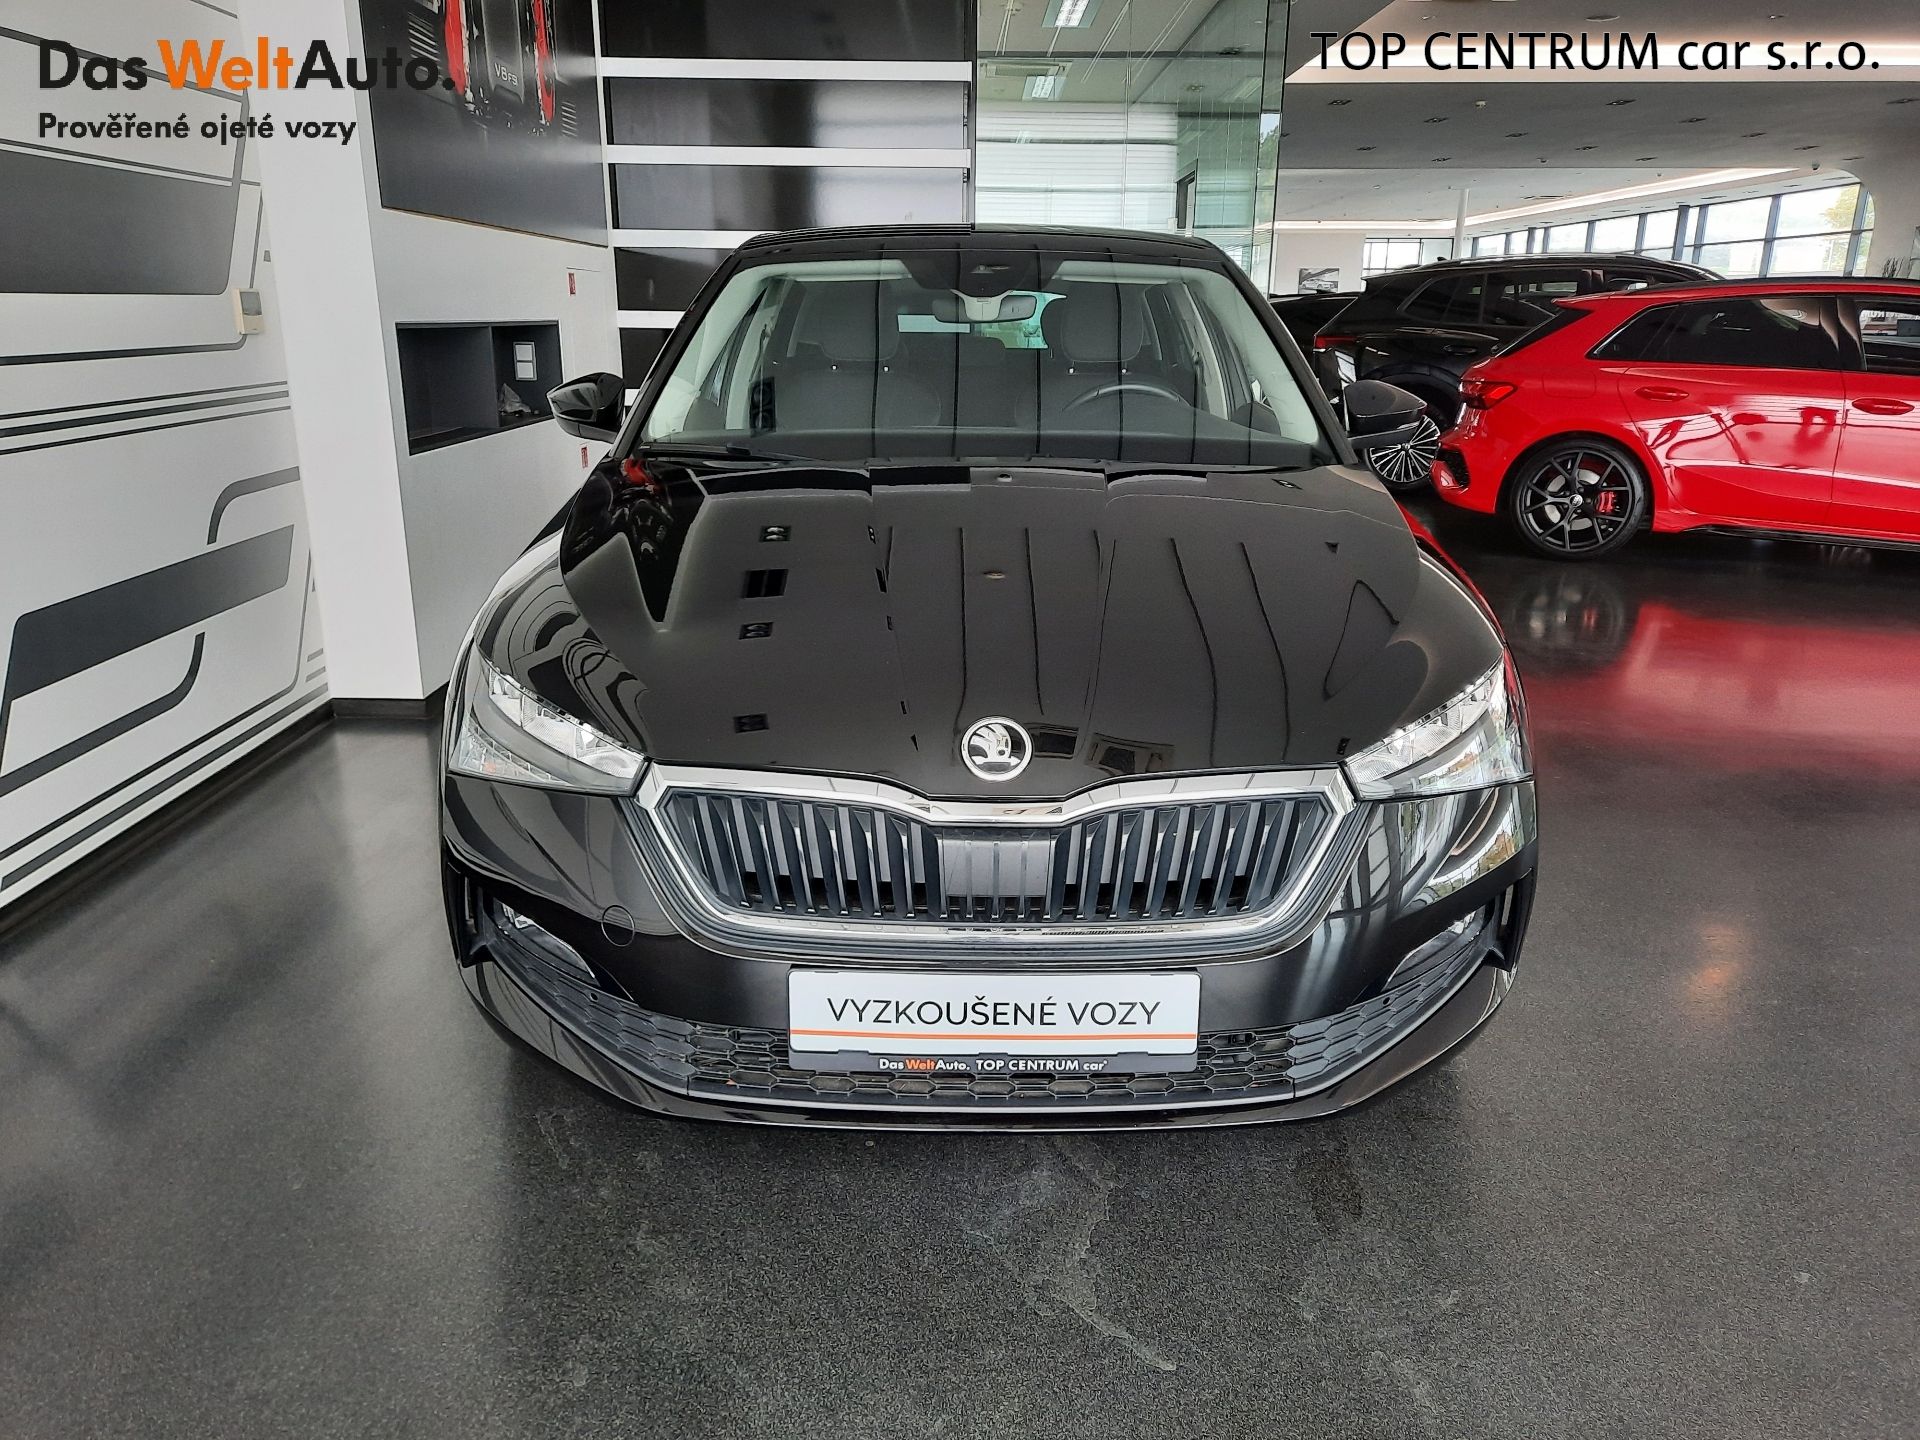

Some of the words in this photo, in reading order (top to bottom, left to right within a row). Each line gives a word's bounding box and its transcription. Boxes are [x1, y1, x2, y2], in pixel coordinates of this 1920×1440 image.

[827, 995, 1057, 1026] VYZKOUŠENÉ
[1067, 1001, 1161, 1026] VOZY
[879, 1058, 905, 1072] Das
[905, 1058, 971, 1073] WeltAuto.
[975, 1059, 1005, 1073] TOP
[1009, 1059, 1079, 1073] CENTRUM
